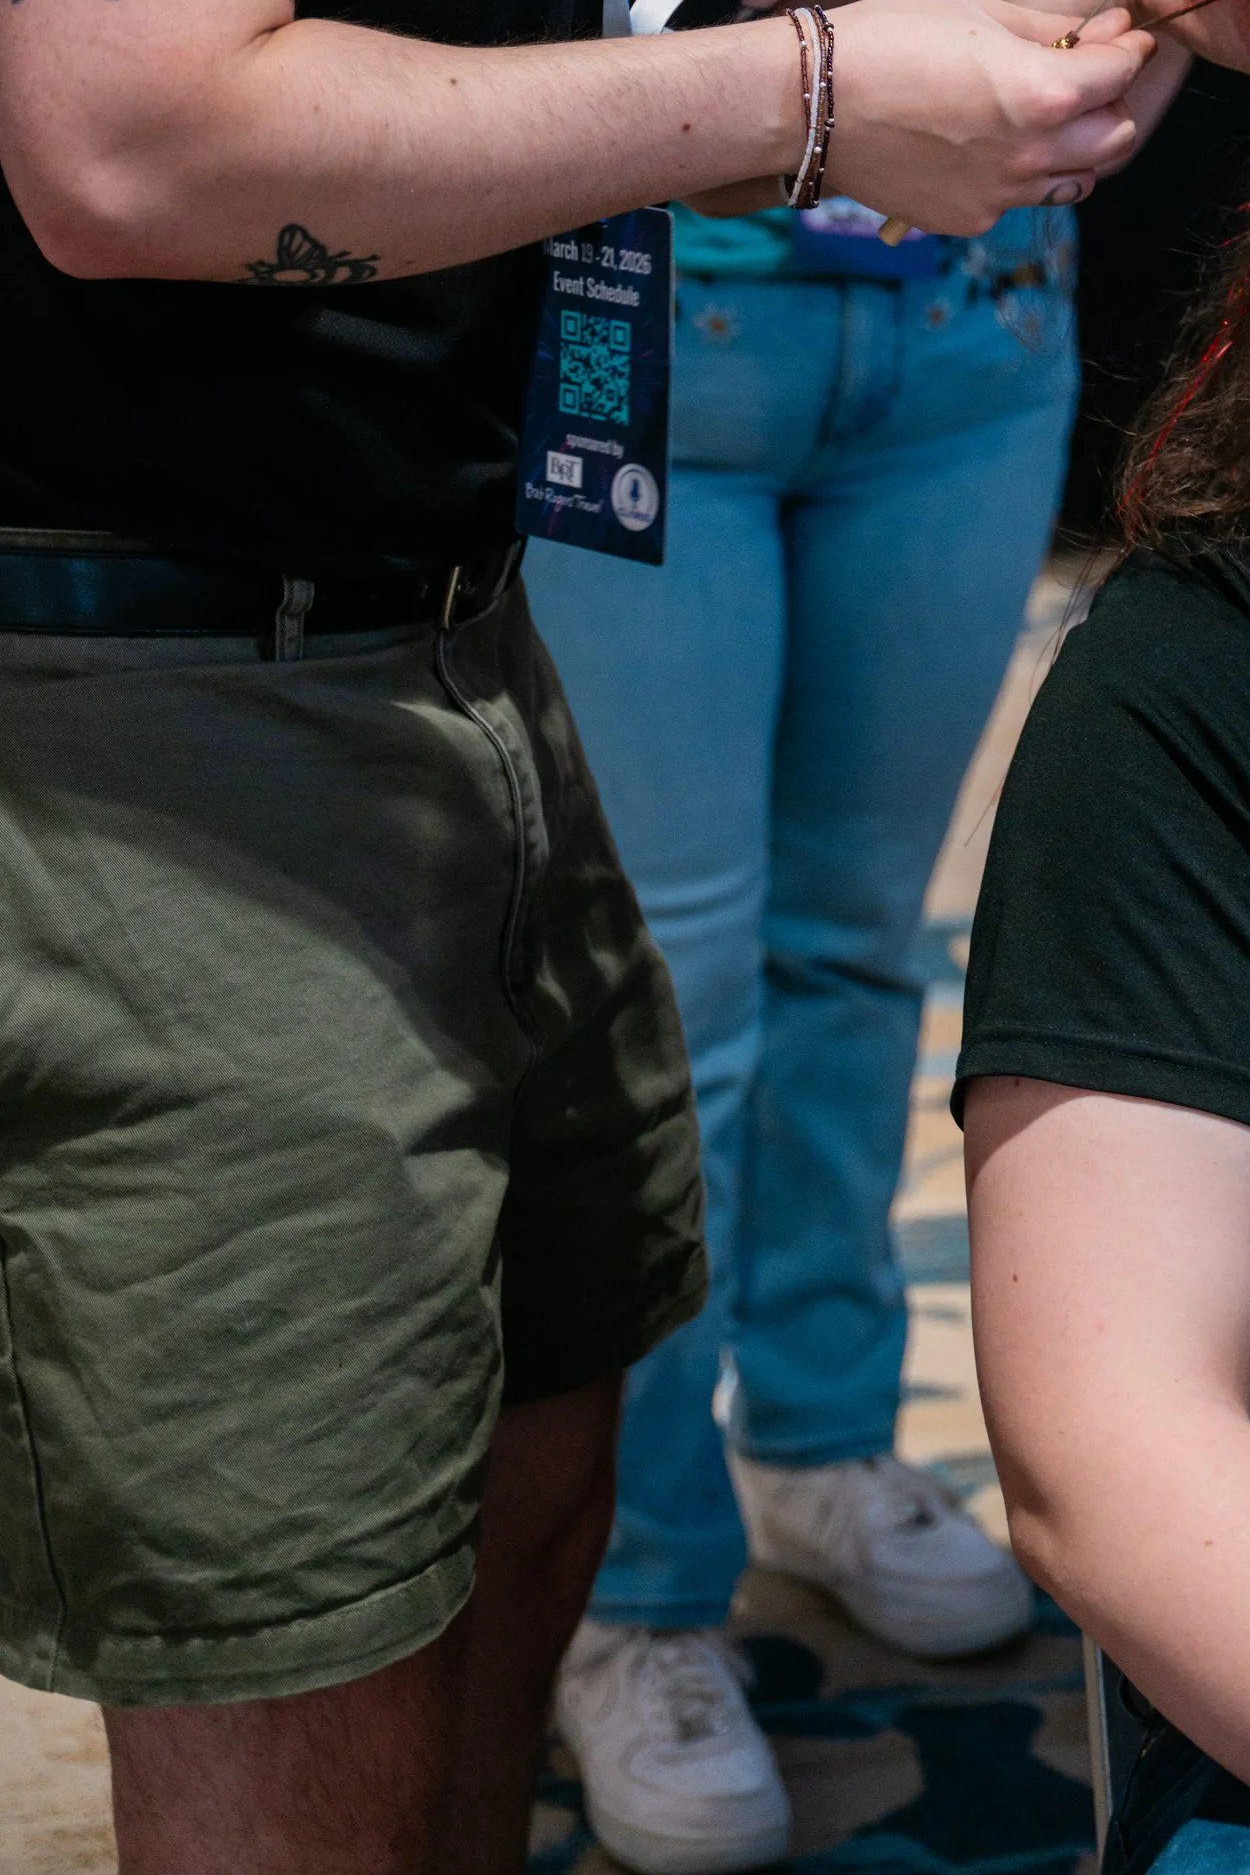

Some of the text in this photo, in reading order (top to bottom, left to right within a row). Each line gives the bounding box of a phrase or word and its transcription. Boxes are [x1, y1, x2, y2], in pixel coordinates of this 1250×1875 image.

[581, 243, 594, 264] 19
[553, 271, 640, 307] Event Schedule
